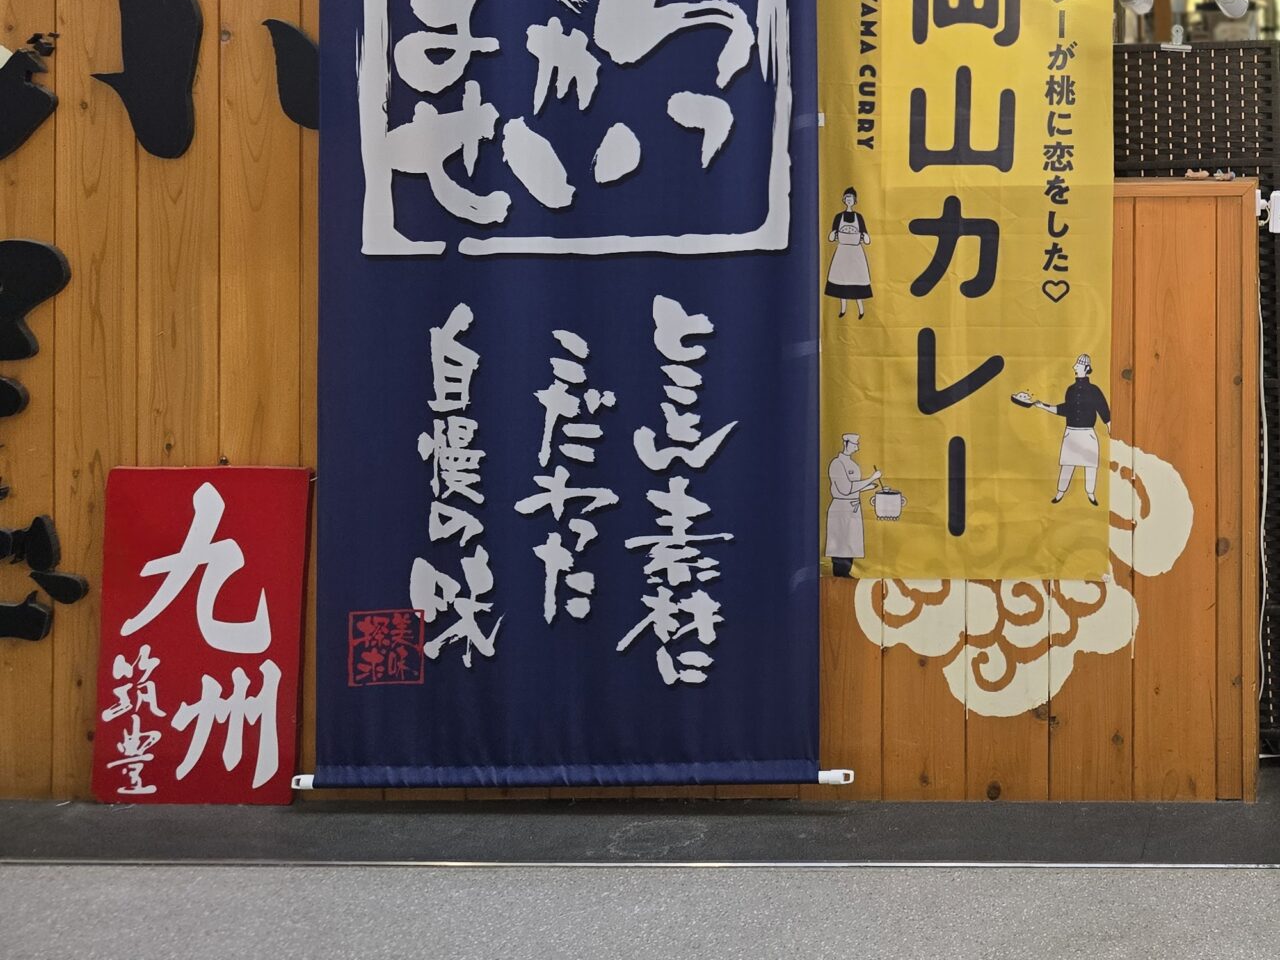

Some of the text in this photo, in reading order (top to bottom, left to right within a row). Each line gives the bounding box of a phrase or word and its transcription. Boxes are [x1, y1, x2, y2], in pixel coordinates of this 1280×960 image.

[856, 63, 878, 151] CURRY
[409, 302, 507, 668] 自慢の味
[514, 329, 619, 624] こだわった
[102, 643, 167, 795] 筑豊
[119, 481, 282, 789] 九州
